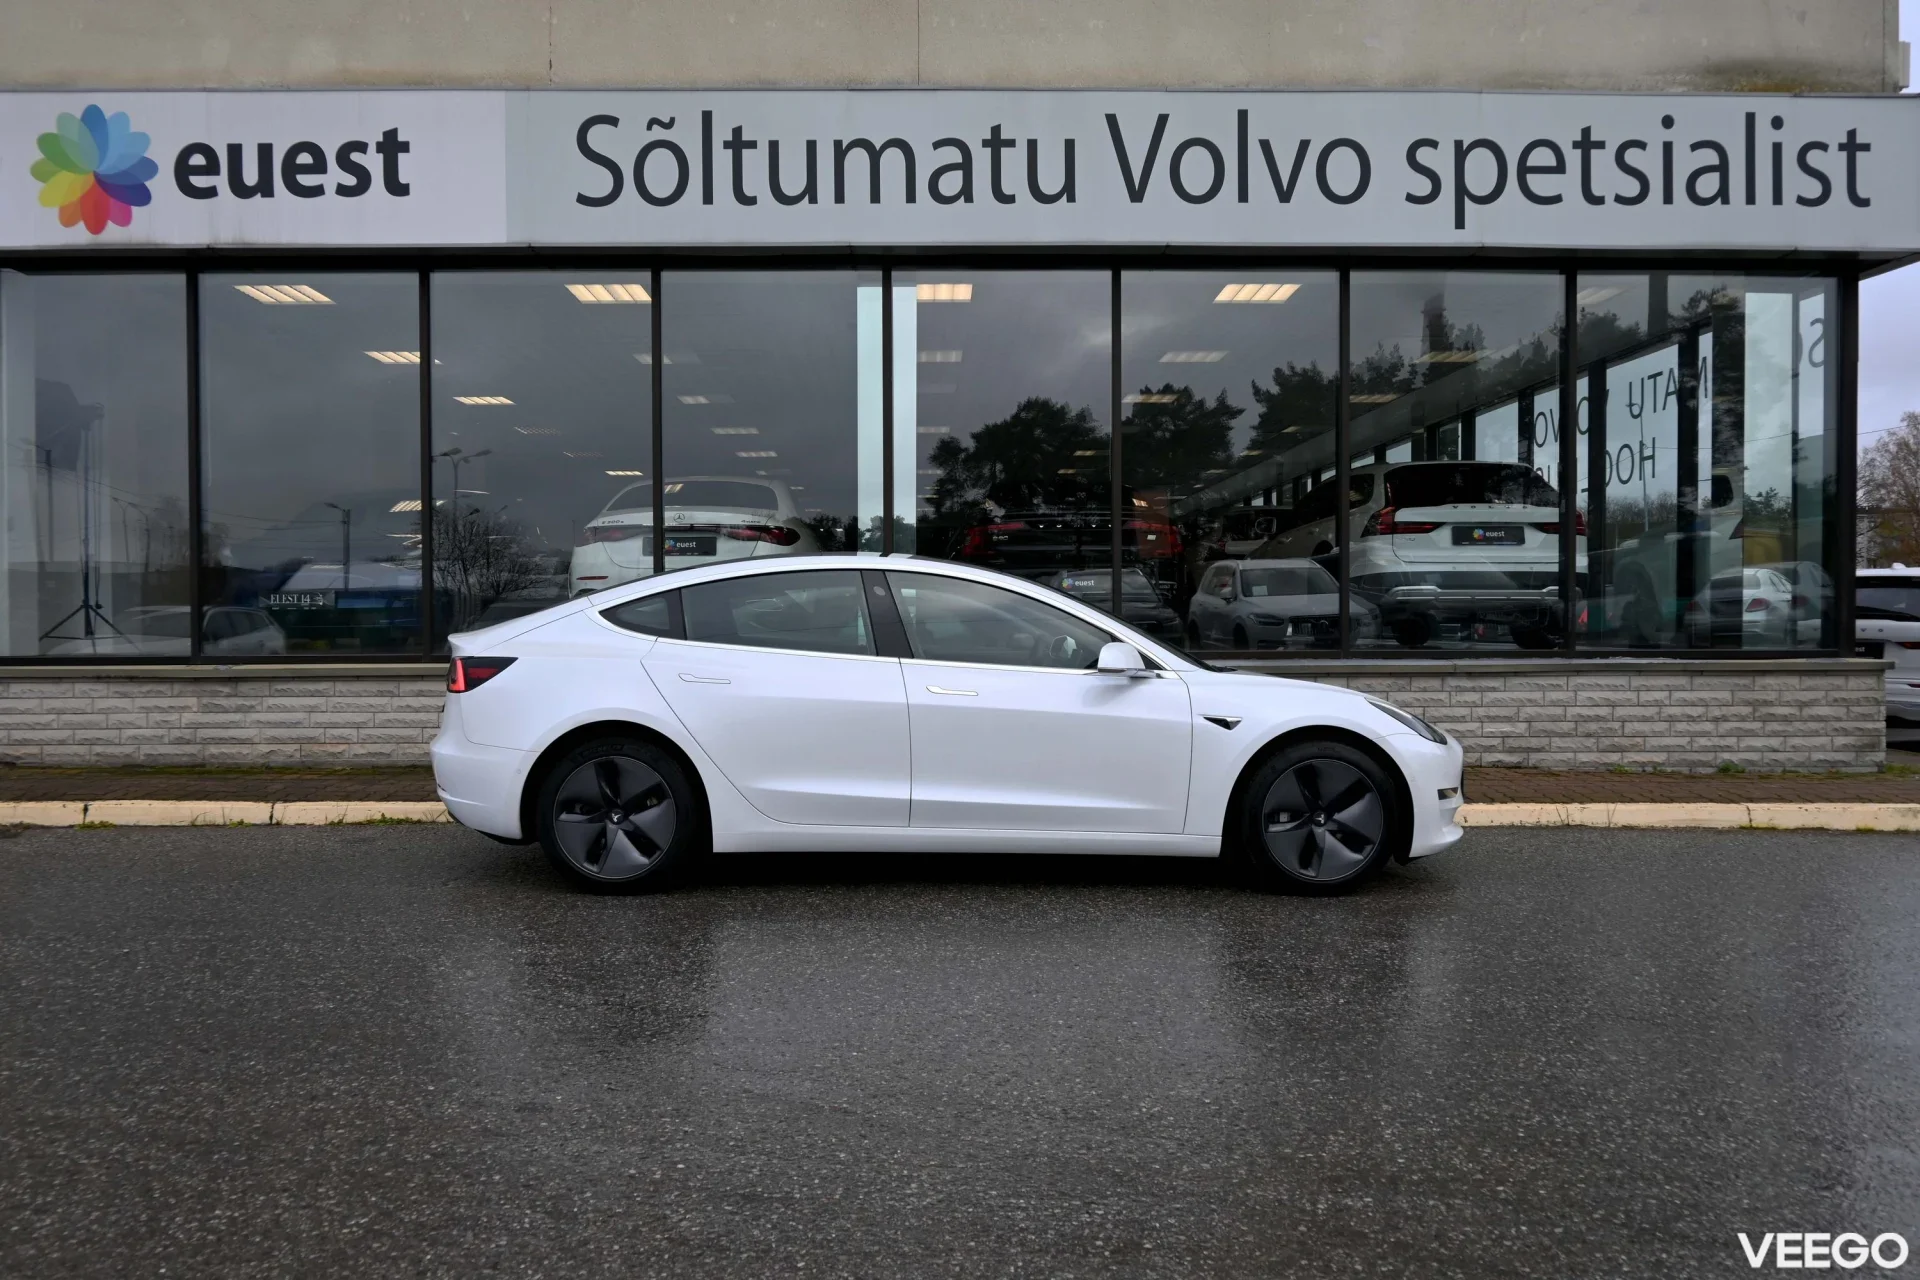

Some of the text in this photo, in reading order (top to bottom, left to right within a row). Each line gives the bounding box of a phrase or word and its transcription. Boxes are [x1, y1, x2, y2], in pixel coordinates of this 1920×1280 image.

[173, 127, 411, 200] euest
[575, 108, 1872, 230] Sõltumatu Volvo spetsialist
[301, 593, 311, 604] 14
